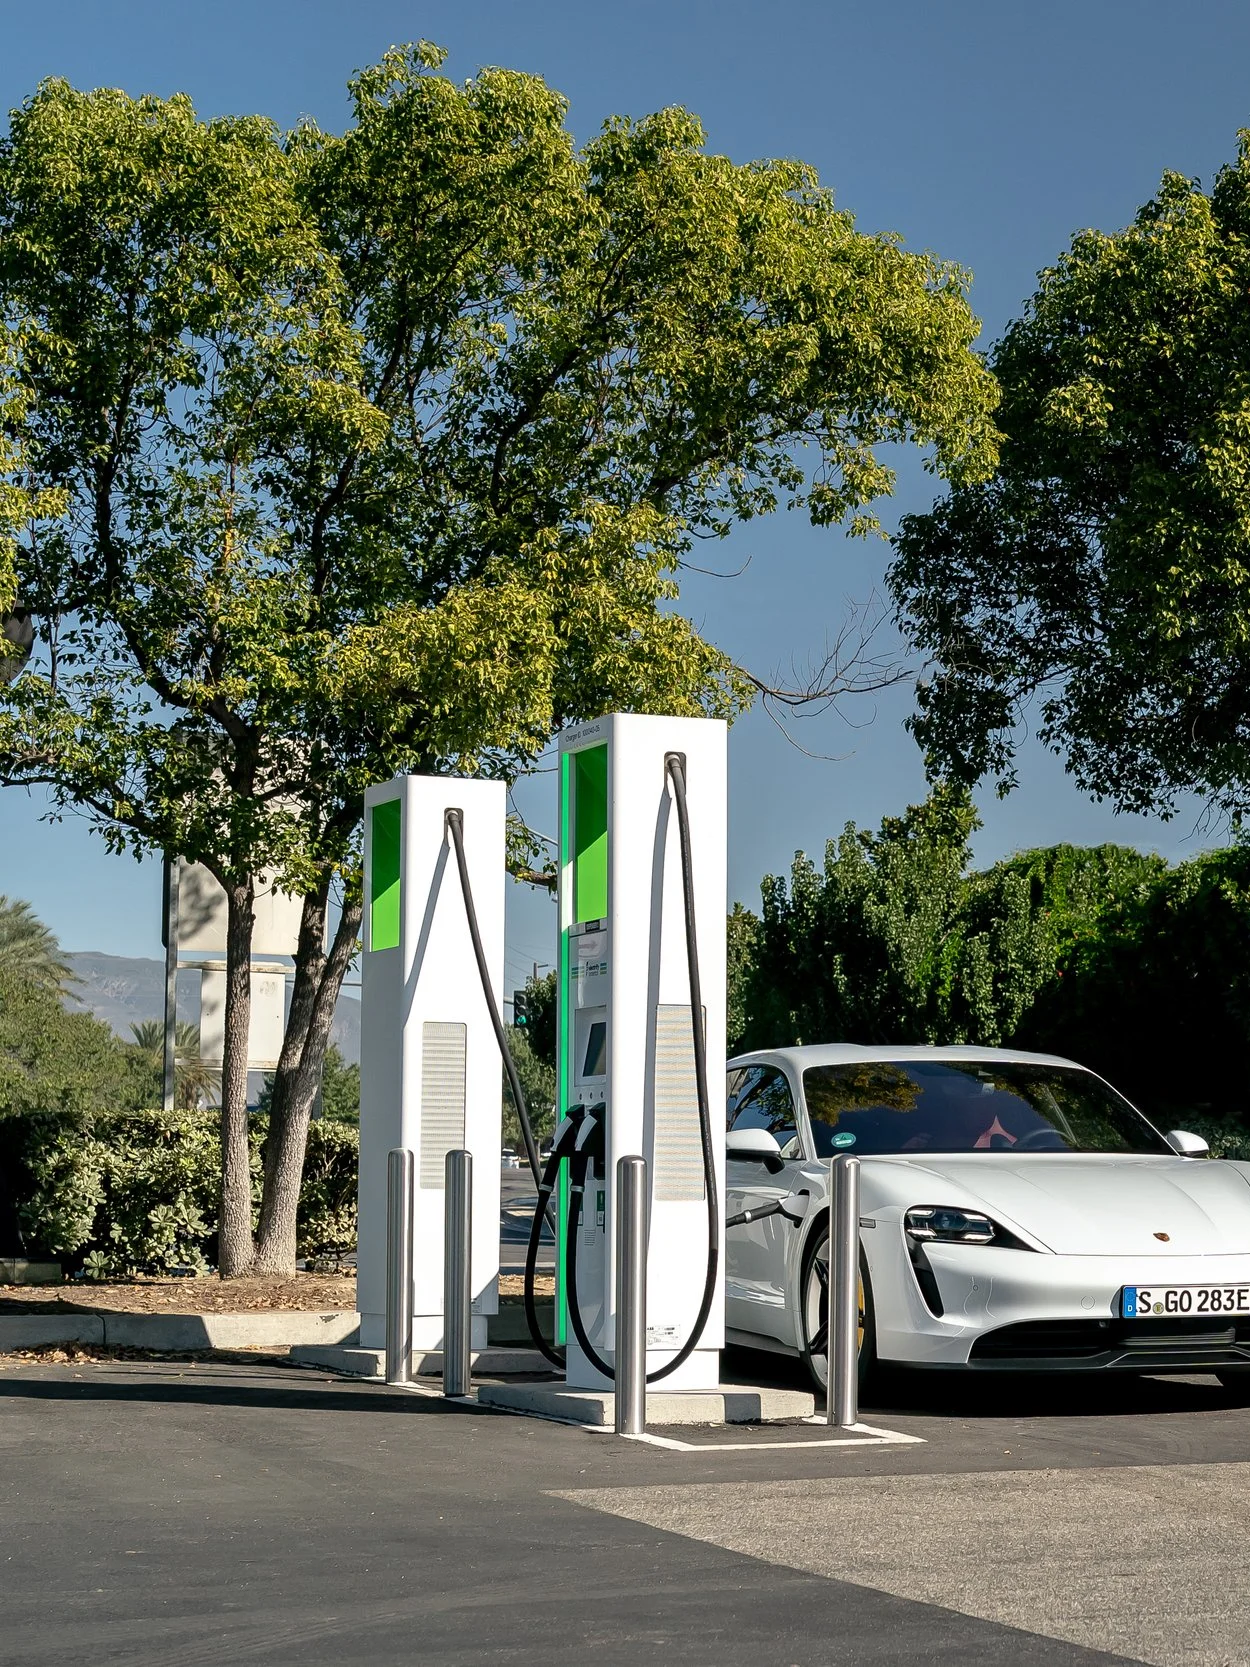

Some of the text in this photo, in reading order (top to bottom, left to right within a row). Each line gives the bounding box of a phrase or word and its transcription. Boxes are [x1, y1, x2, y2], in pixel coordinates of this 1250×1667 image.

[1127, 1304, 1133, 1312] D
[1138, 1289, 1250, 1313] S GO 283E
